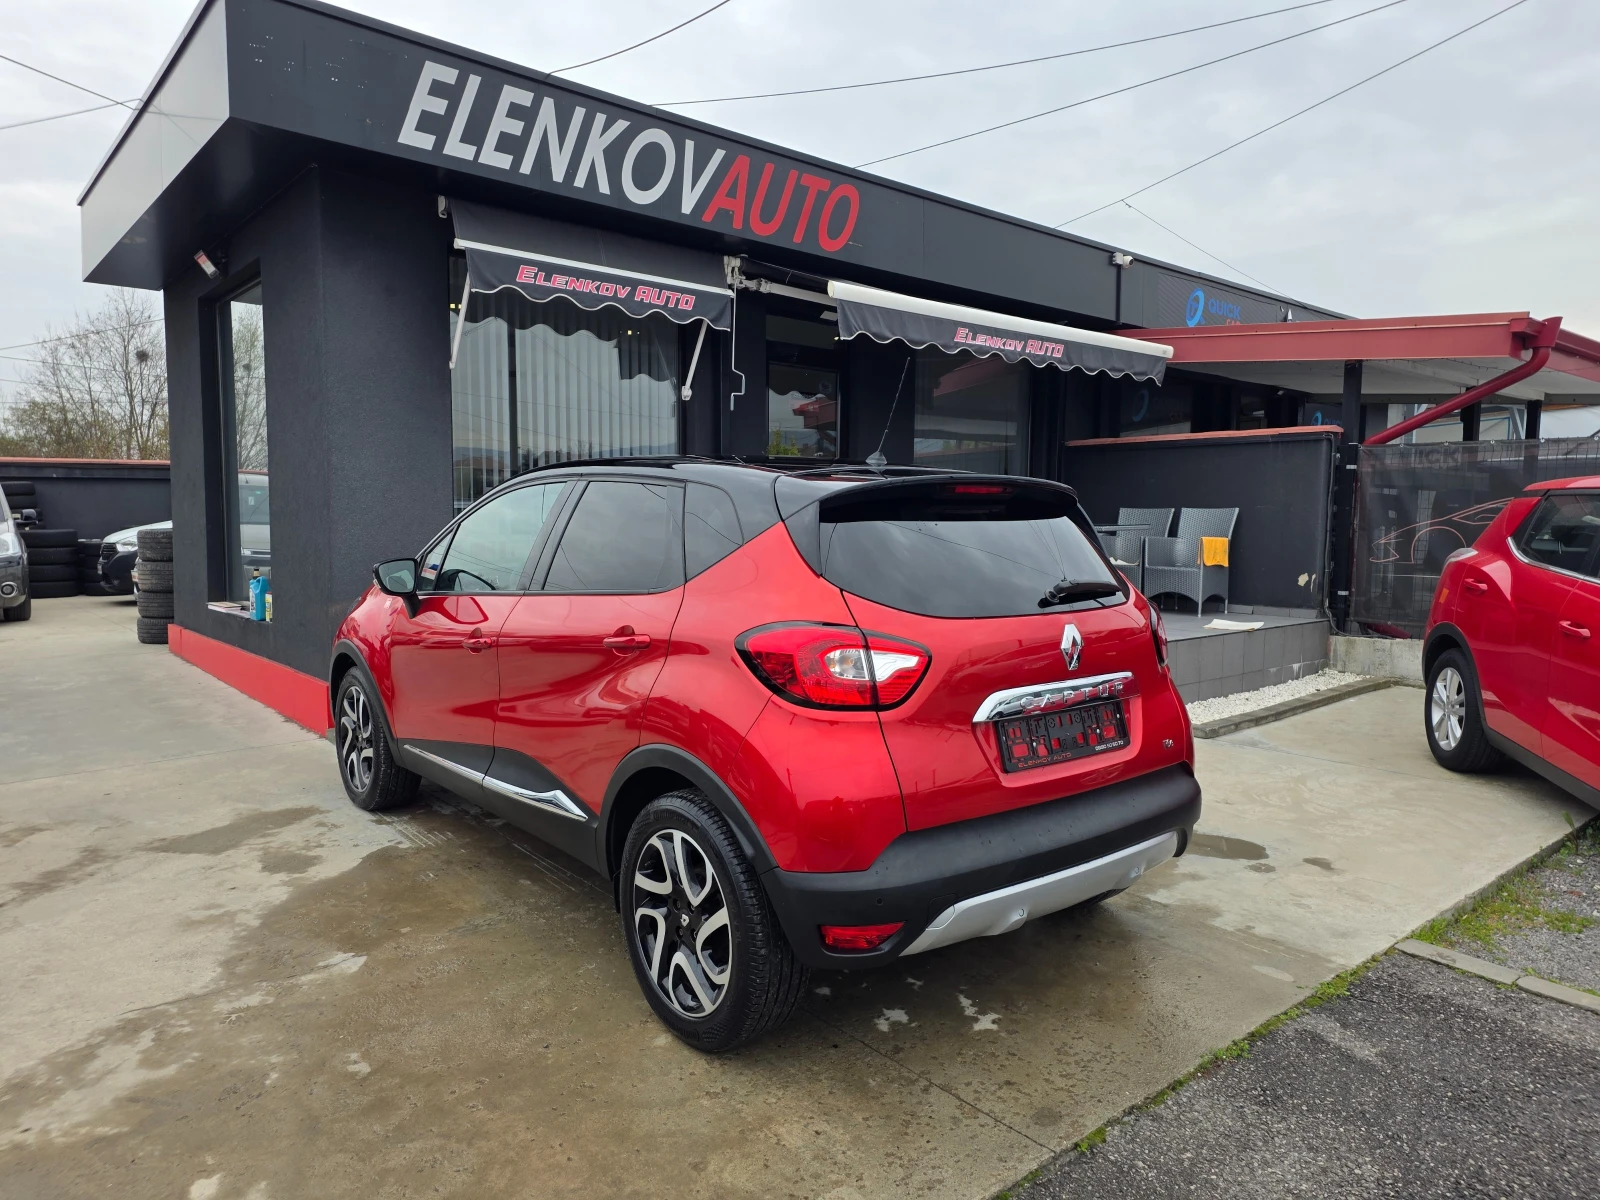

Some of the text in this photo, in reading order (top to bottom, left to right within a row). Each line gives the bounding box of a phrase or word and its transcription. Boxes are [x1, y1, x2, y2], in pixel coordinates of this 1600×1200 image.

[516, 265, 696, 311] ELENKOV AUTO
[1208, 299, 1241, 320] QUICK
[954, 327, 1065, 358] ELENKOV AUTO
[1020, 681, 1123, 709] CAPTUR
[1053, 752, 1072, 761] AUTO
